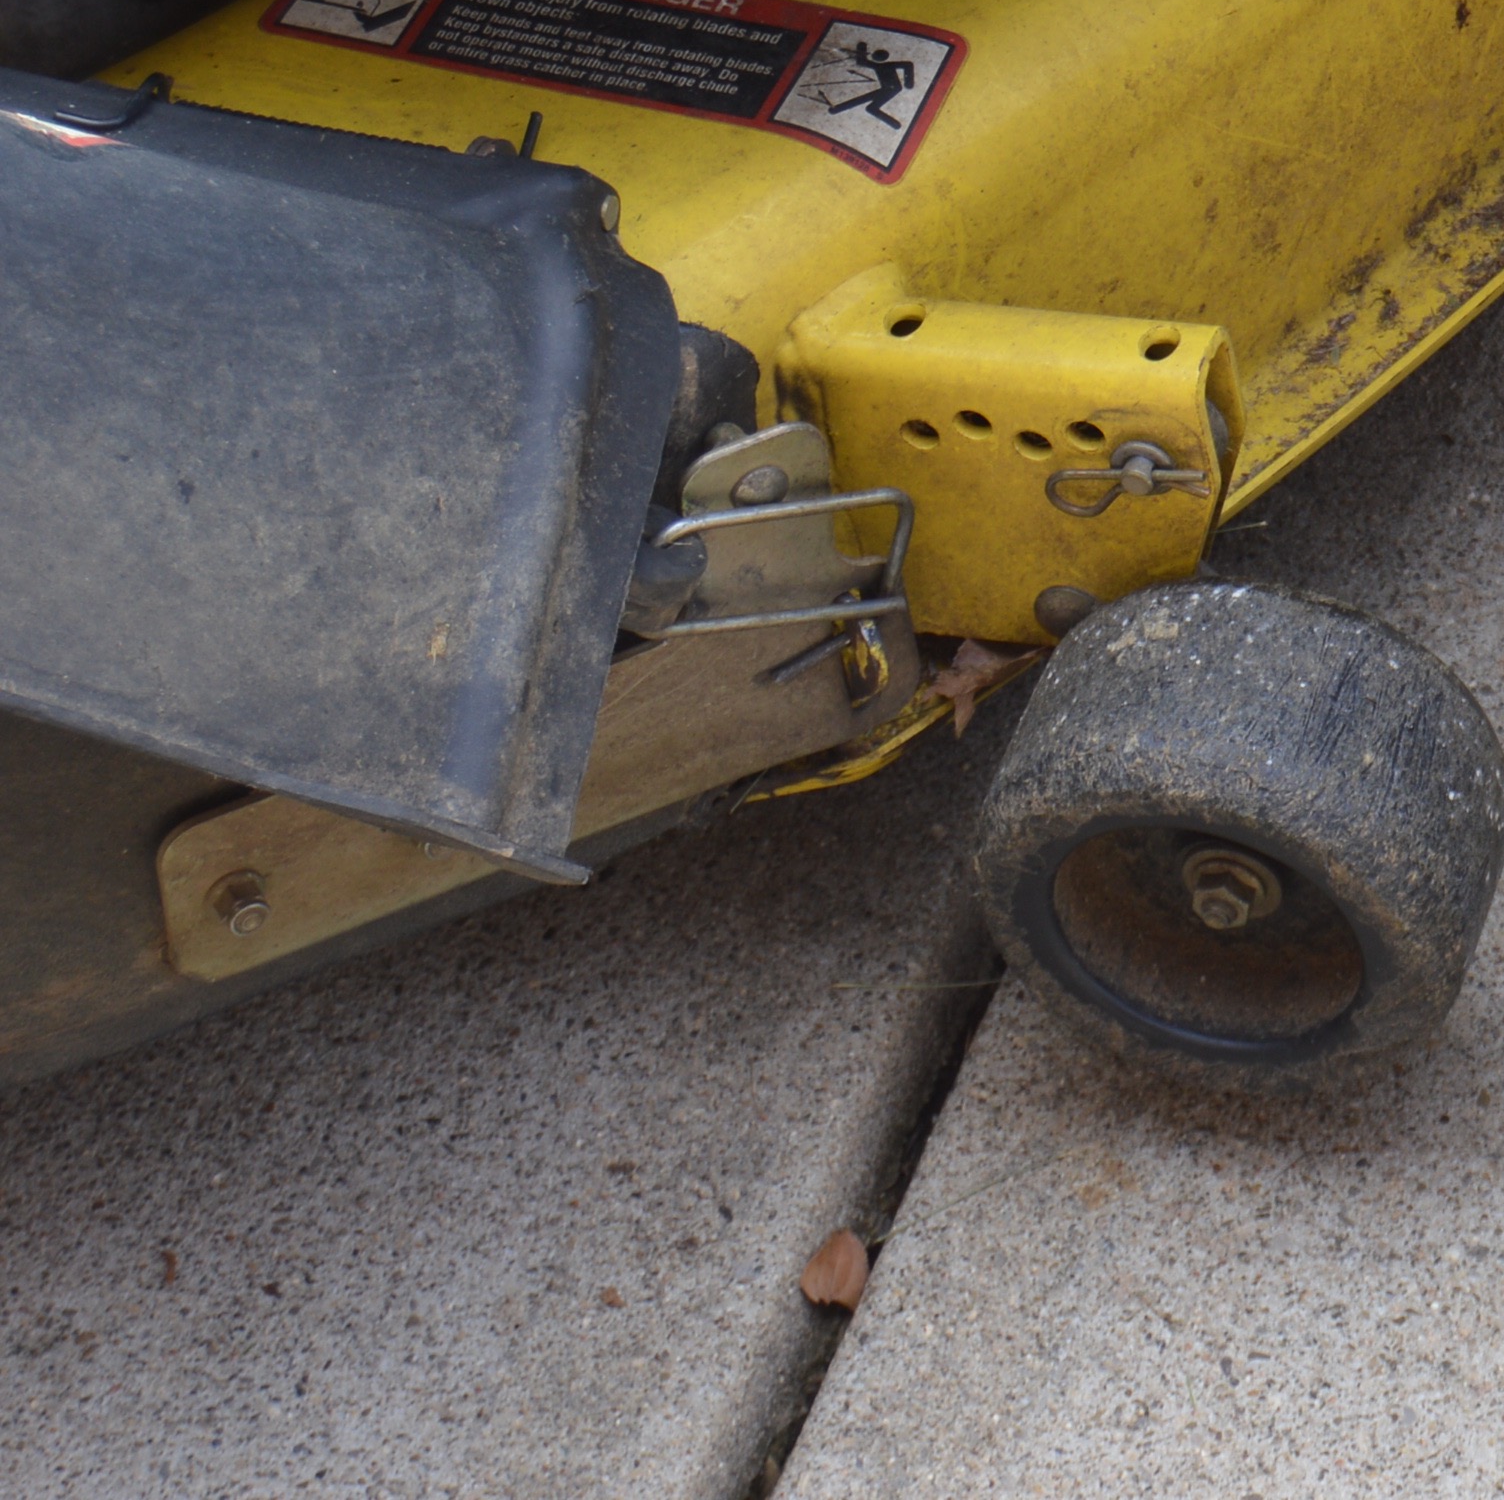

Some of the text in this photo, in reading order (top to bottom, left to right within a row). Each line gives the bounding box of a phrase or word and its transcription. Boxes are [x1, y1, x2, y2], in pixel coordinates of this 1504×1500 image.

[443, 15, 480, 35] Keep
[482, 22, 559, 49] bystanders
[562, 41, 572, 51] a
[575, 42, 606, 57] safe
[609, 48, 668, 69] distance
[718, 68, 739, 82] Do
[452, 4, 775, 76] Keep hands and feet away from rotating blades.
[626, 6, 690, 29] rotating
[693, 17, 746, 39] blades
[750, 29, 784, 45] and
[428, 40, 444, 51] or
[447, 43, 488, 61] entire
[490, 52, 531, 70] grass
[533, 59, 586, 79] catcher
[588, 71, 604, 83] in
[436, 28, 739, 95] not operate mower without discharge chute
